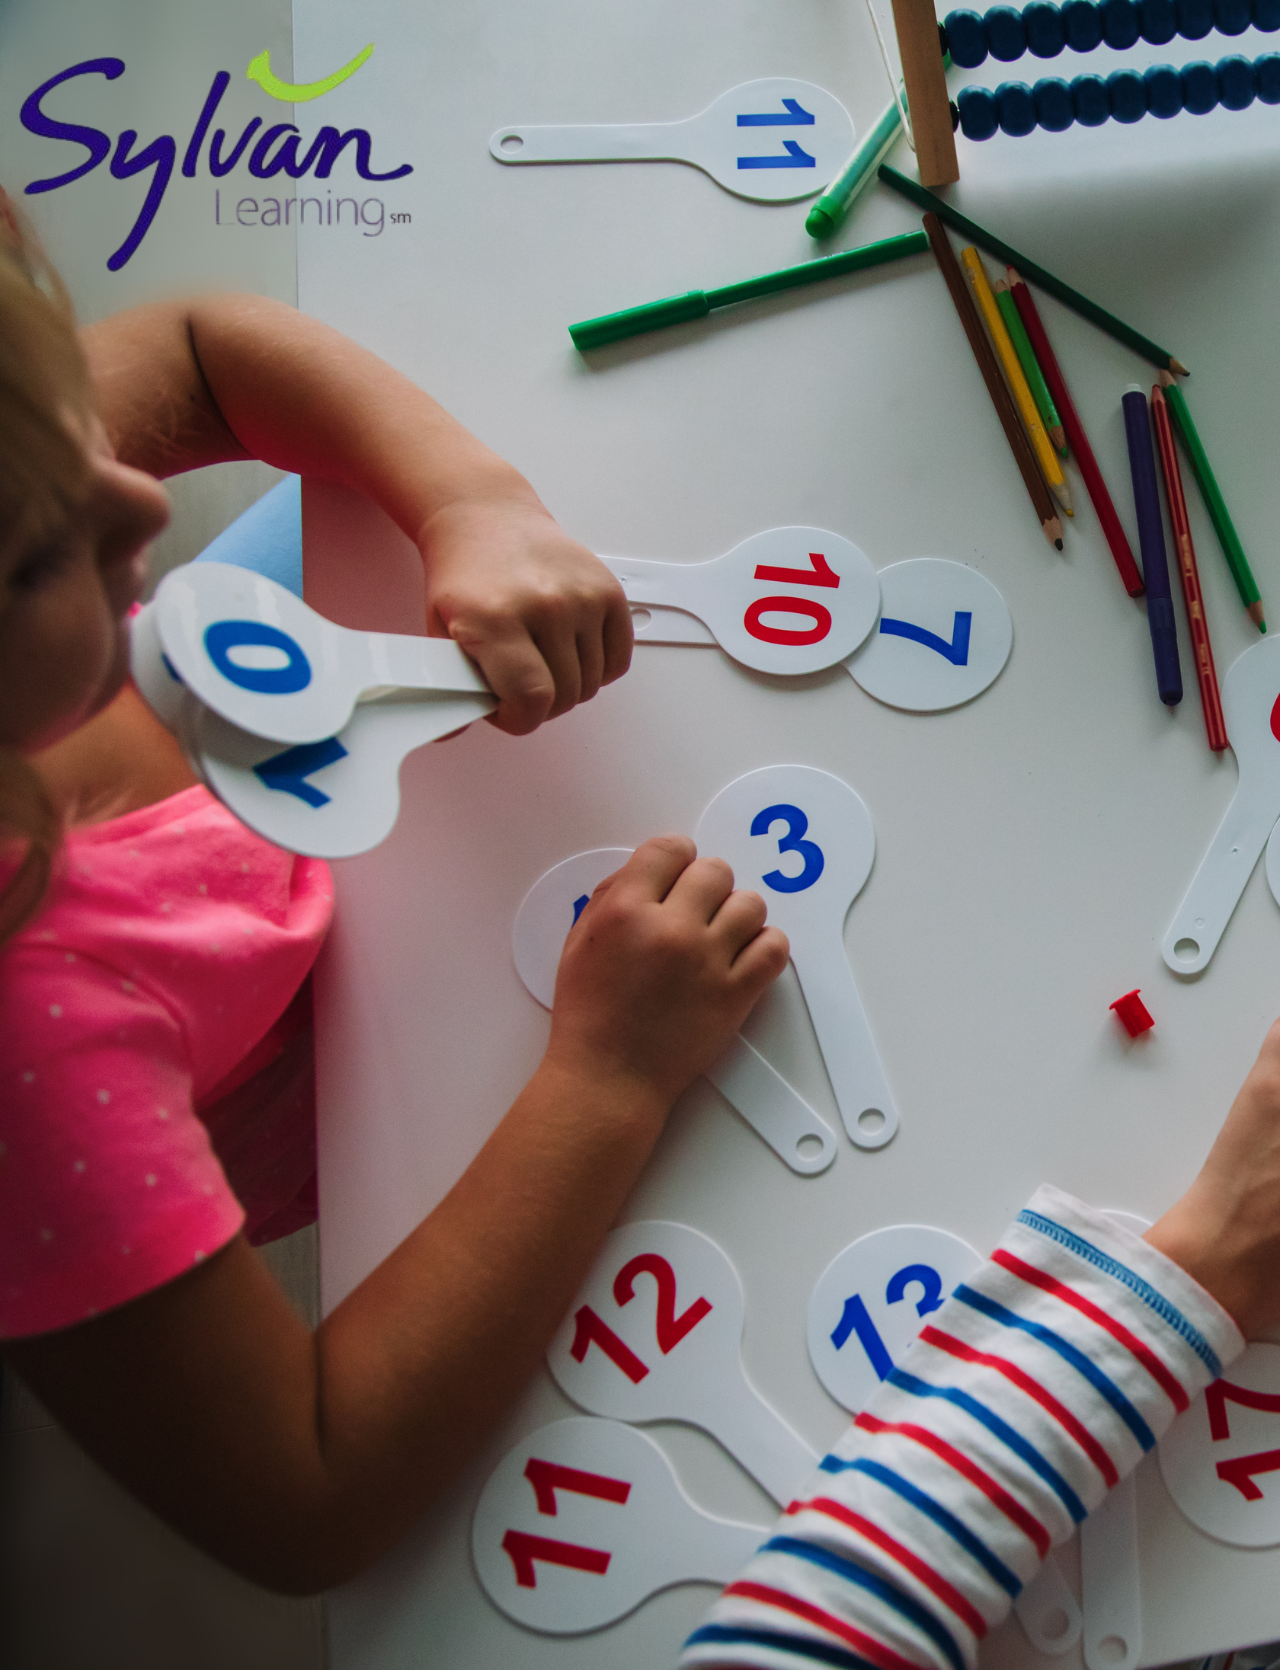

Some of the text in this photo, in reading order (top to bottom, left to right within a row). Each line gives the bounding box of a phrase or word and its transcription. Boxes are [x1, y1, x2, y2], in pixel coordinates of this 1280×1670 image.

[736, 98, 817, 170] 11
[743, 553, 841, 647] 10
[879, 611, 973, 667] 7
[204, 619, 313, 695] 0
[750, 803, 826, 894] 3
[570, 1253, 713, 1384] 12
[502, 1457, 632, 1589] 11
